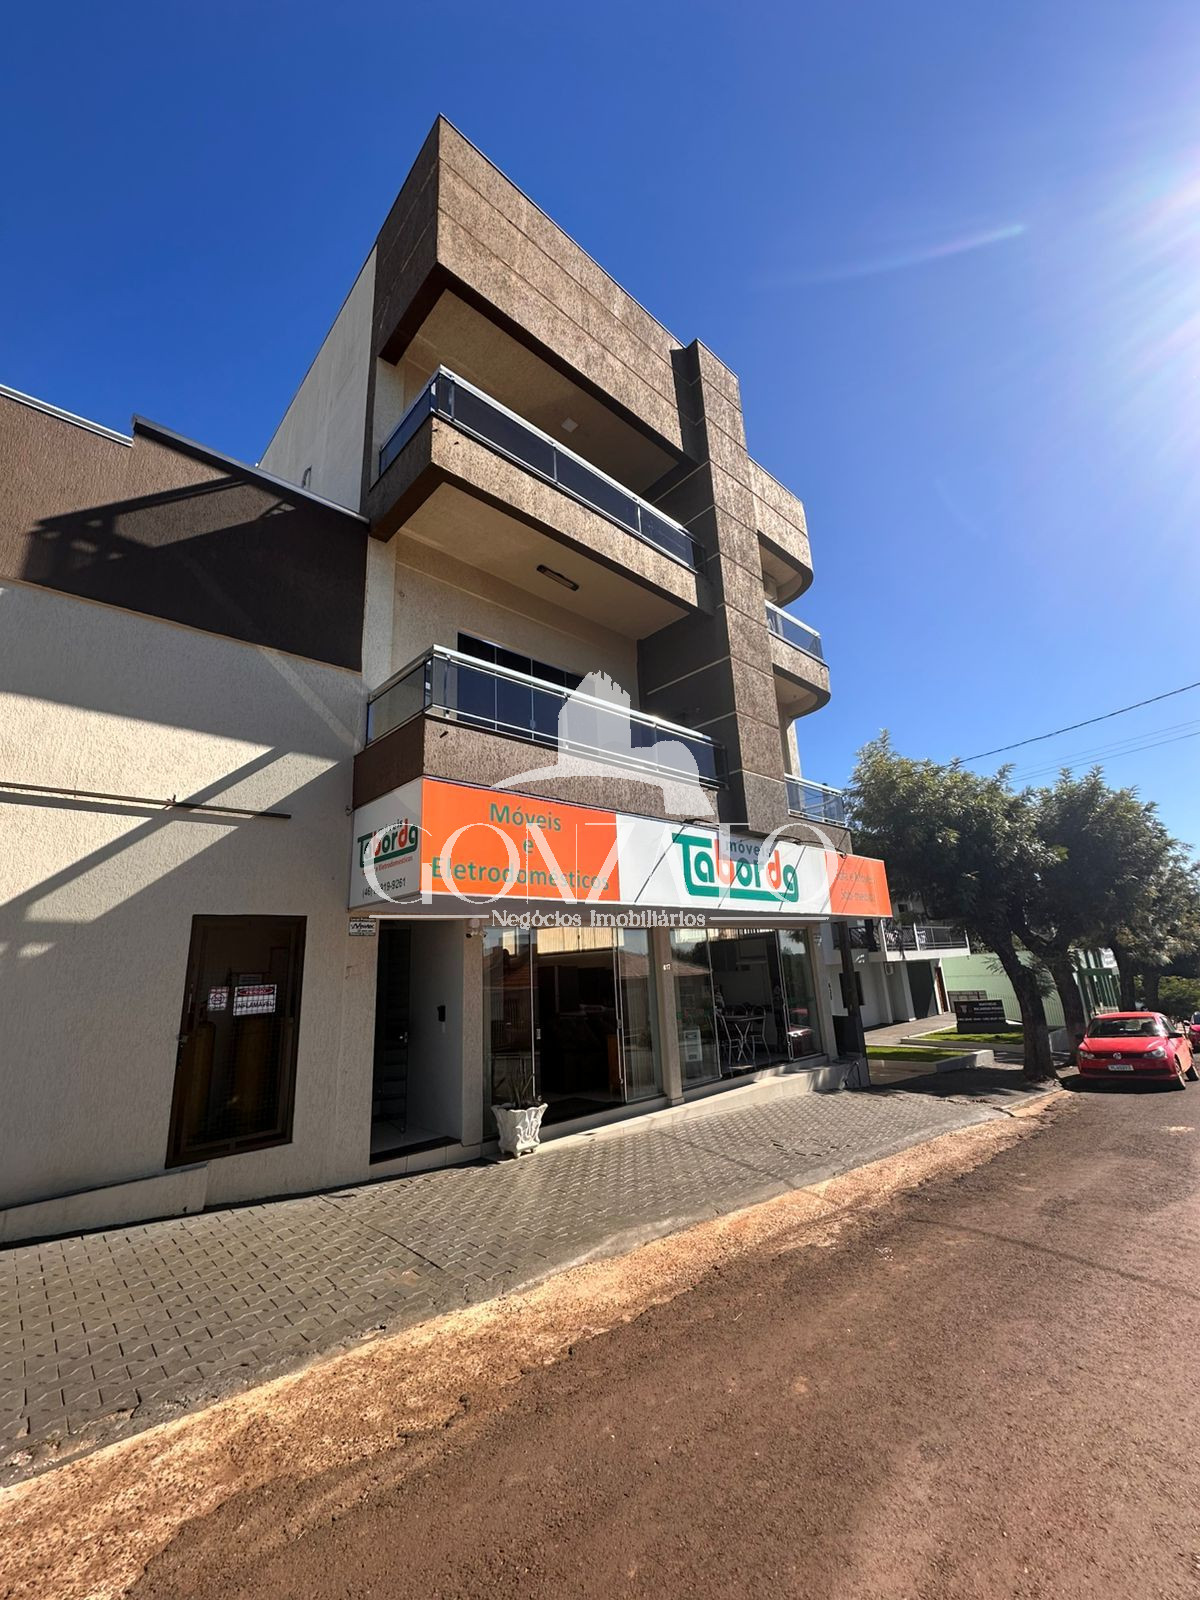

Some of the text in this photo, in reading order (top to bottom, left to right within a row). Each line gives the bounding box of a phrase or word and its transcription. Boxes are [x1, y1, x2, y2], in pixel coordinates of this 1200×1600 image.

[489, 803, 562, 832] Móveis
[523, 838, 534, 853] e
[432, 856, 610, 891] Eletrodomésticos
[671, 832, 799, 903] Taborda
